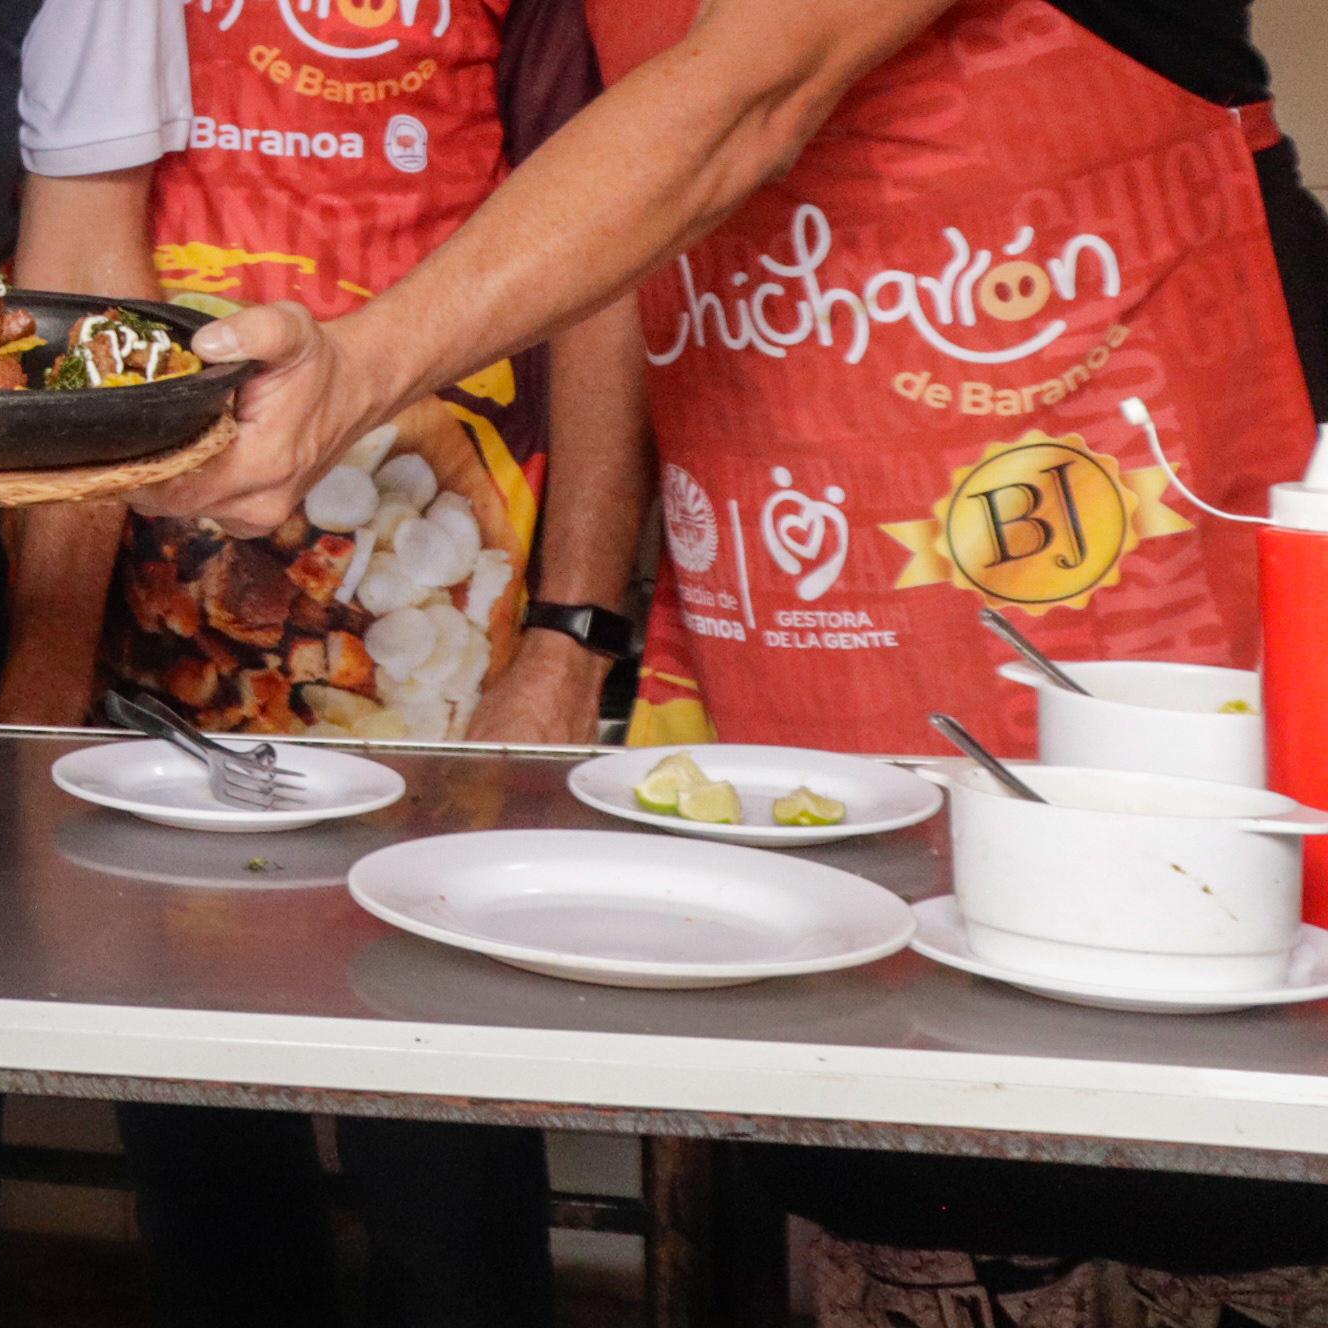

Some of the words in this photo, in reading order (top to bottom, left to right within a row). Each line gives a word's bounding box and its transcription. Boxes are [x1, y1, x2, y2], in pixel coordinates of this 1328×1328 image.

[249, 44, 292, 84] de
[295, 59, 437, 103] Baranoa
[190, 115, 364, 158] Baranoa
[892, 371, 953, 409] de
[960, 324, 1132, 416] Baranoa
[968, 460, 1088, 570] BJ
[764, 630, 793, 647] DE
[795, 631, 821, 649] LA
[824, 630, 899, 649] GENTE
[776, 611, 874, 629] GESTORA
